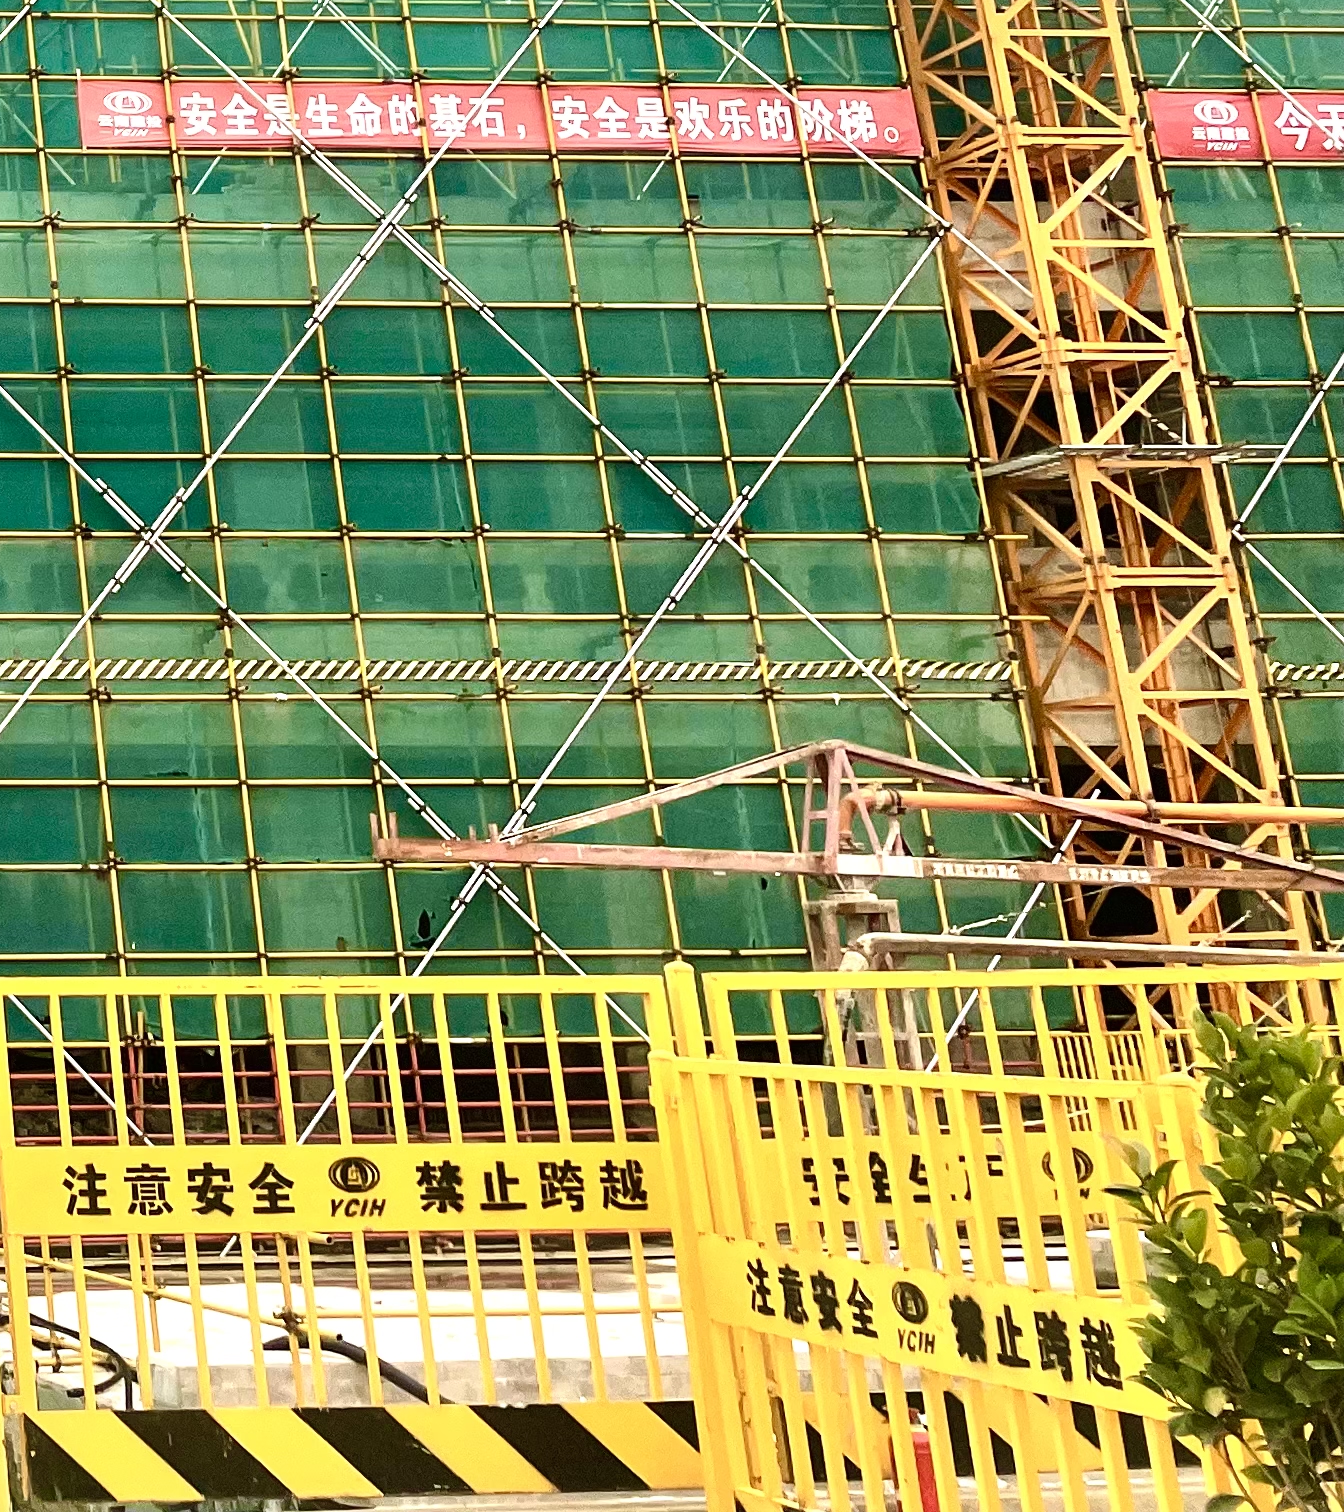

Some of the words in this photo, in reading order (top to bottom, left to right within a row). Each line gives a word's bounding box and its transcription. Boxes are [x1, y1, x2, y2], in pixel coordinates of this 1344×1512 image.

[62, 1162, 296, 1217] 注意安全
[329, 1197, 385, 1217] YCIH
[416, 1159, 649, 1213] 禁止跨越
[747, 1258, 878, 1339] 注意安全
[897, 1328, 936, 1354] YCIH
